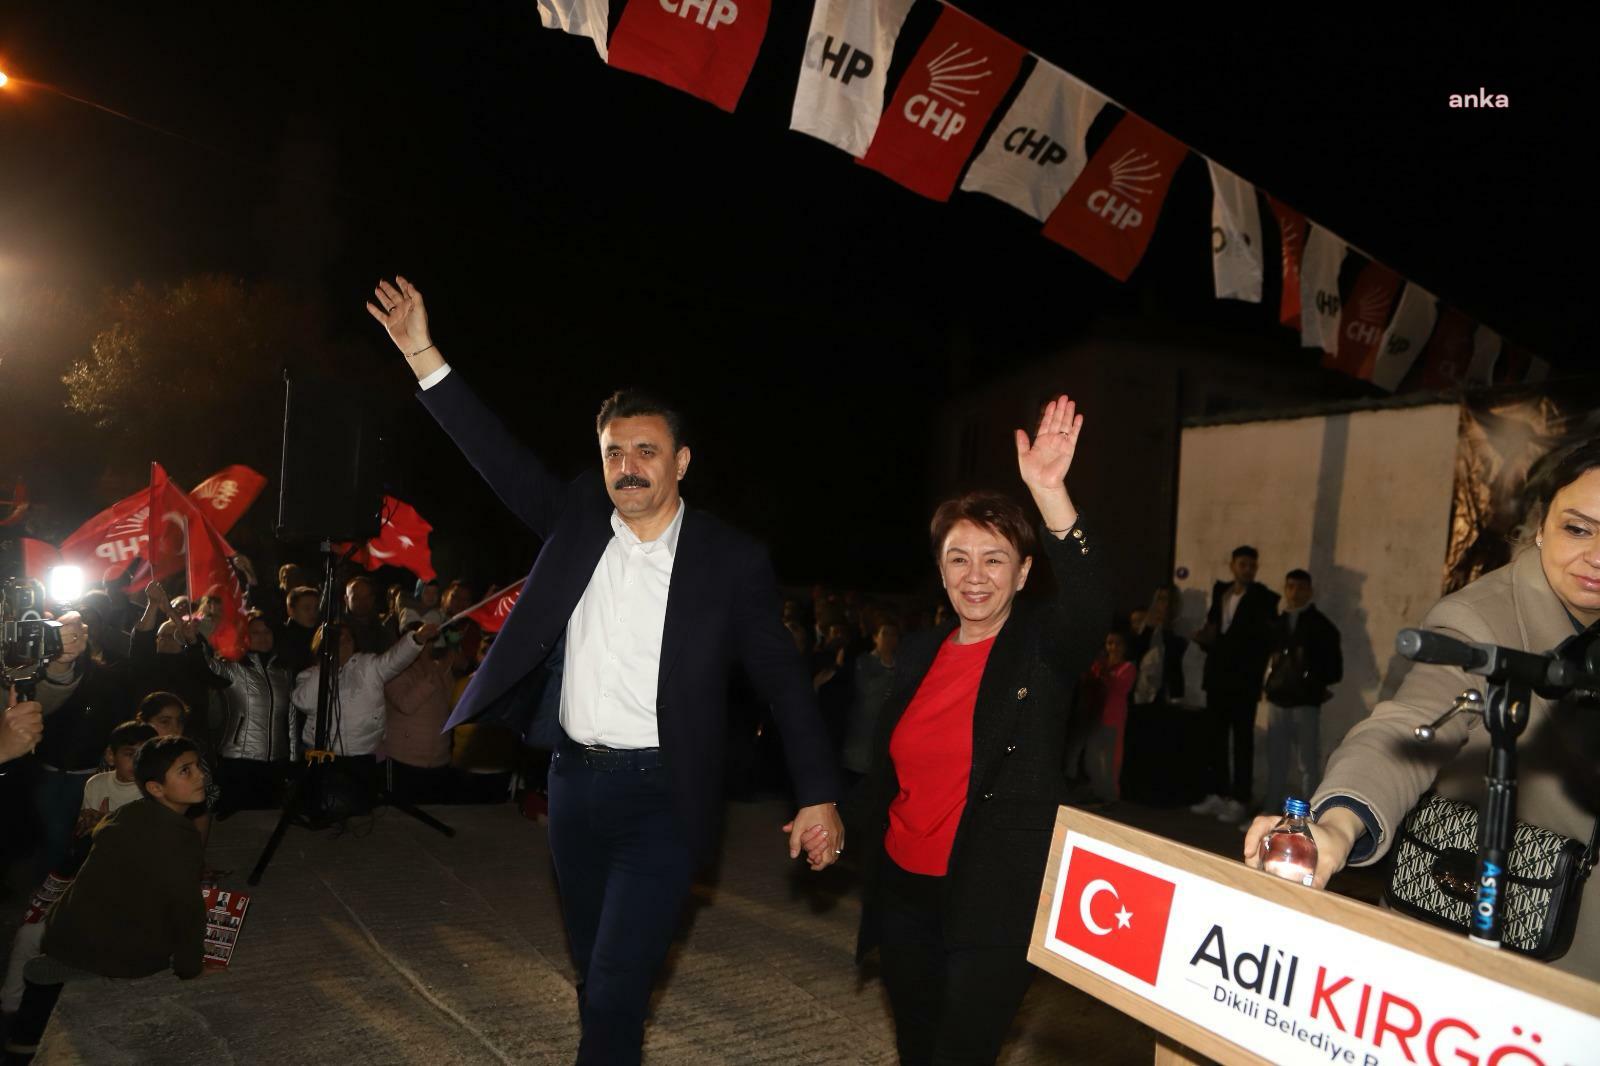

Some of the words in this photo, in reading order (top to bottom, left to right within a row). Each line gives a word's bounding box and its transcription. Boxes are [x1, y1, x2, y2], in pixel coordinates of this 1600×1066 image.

[805, 31, 874, 85] CHP
[903, 94, 967, 142] CHP
[1003, 127, 1067, 168] CHP
[1086, 190, 1143, 231] CHP
[1189, 923, 1299, 1007] Adil
[1213, 985, 1259, 1019] Dikili
[1264, 1008, 1356, 1063] Belediye
